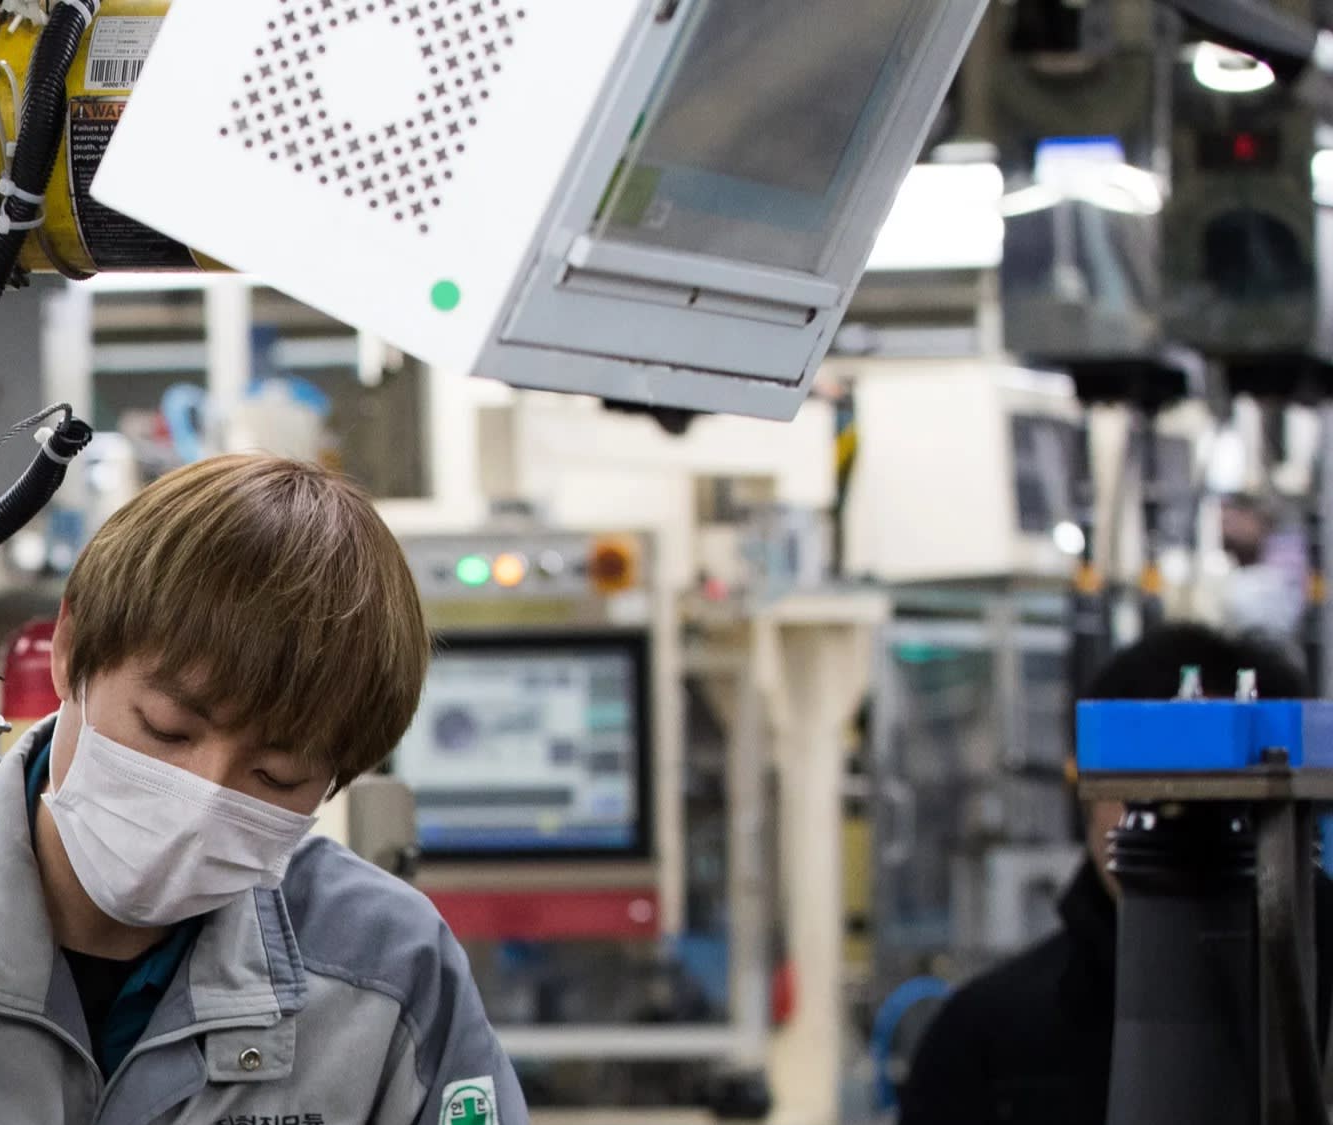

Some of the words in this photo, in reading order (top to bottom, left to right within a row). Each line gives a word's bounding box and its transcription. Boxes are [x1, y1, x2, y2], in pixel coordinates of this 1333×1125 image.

[73, 124, 99, 132] Failure
[100, 124, 109, 132] to
[73, 133, 109, 143] warnings
